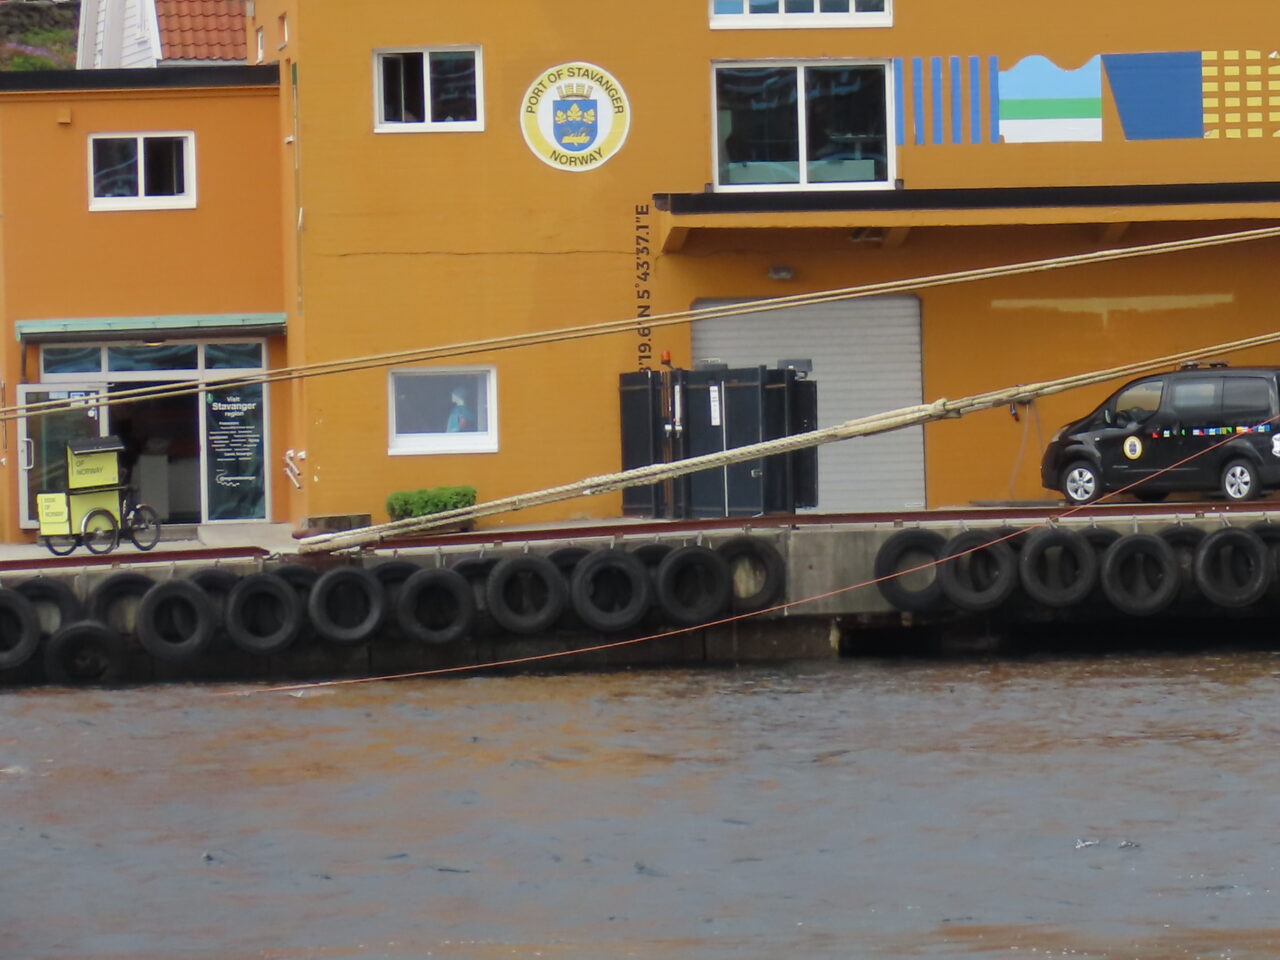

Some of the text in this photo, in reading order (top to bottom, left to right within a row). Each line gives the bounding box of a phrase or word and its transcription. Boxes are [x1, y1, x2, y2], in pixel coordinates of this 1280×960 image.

[526, 67, 624, 115] PORT OF STAVANGER
[549, 147, 603, 166] NORWAY
[212, 402, 257, 411] Stavanger
